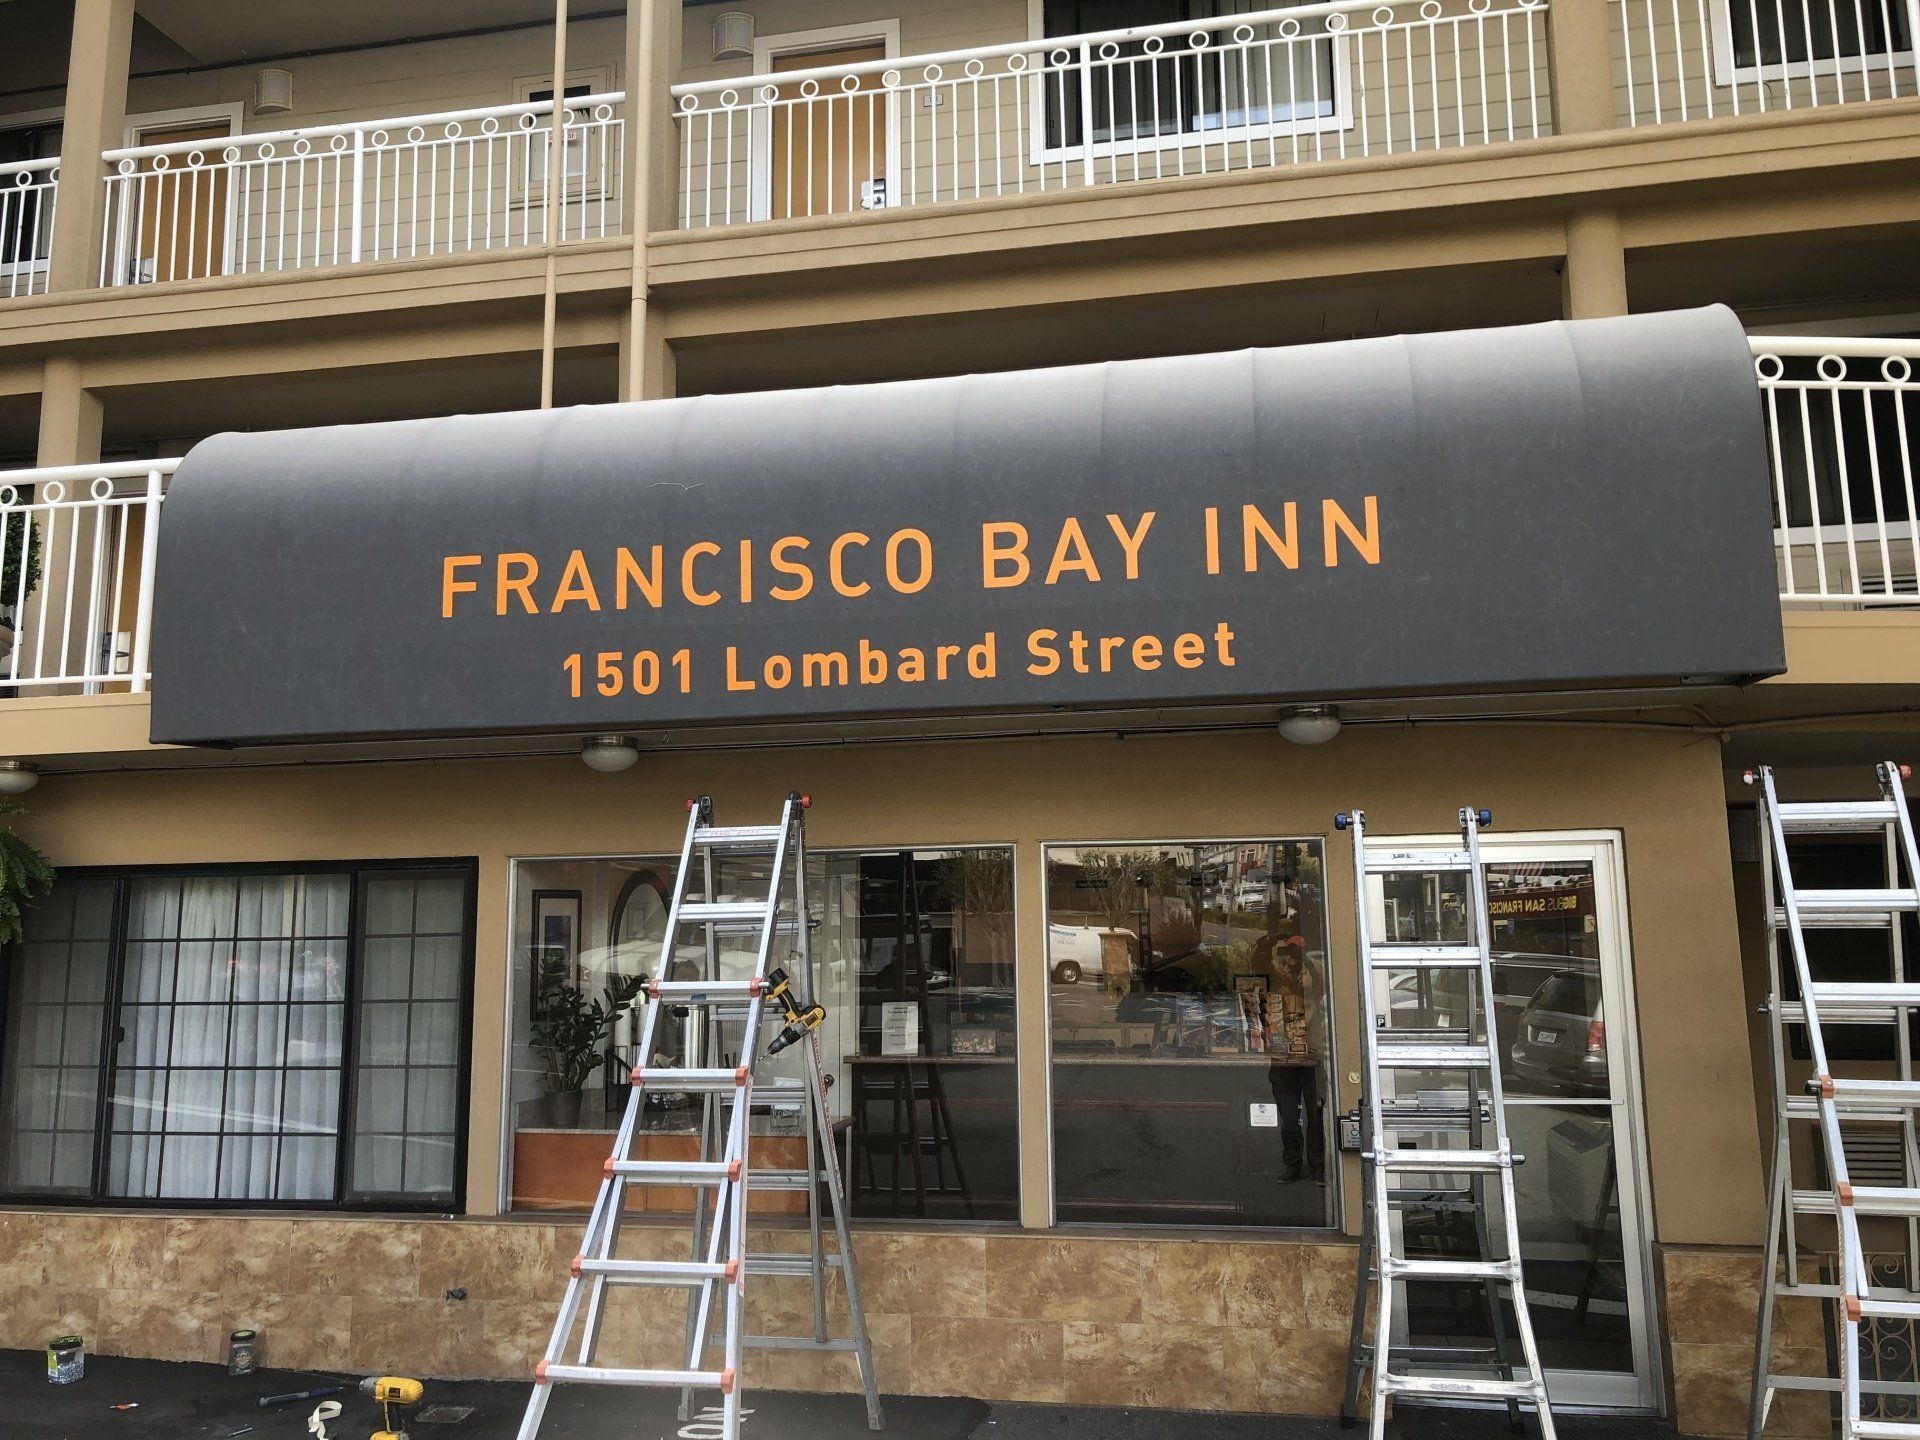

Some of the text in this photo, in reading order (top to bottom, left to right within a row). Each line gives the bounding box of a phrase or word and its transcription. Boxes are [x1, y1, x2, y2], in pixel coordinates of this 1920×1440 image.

[442, 495, 1381, 617] FRANCISCO BAY INN
[563, 622, 1236, 697] 1501 Lombard Street
